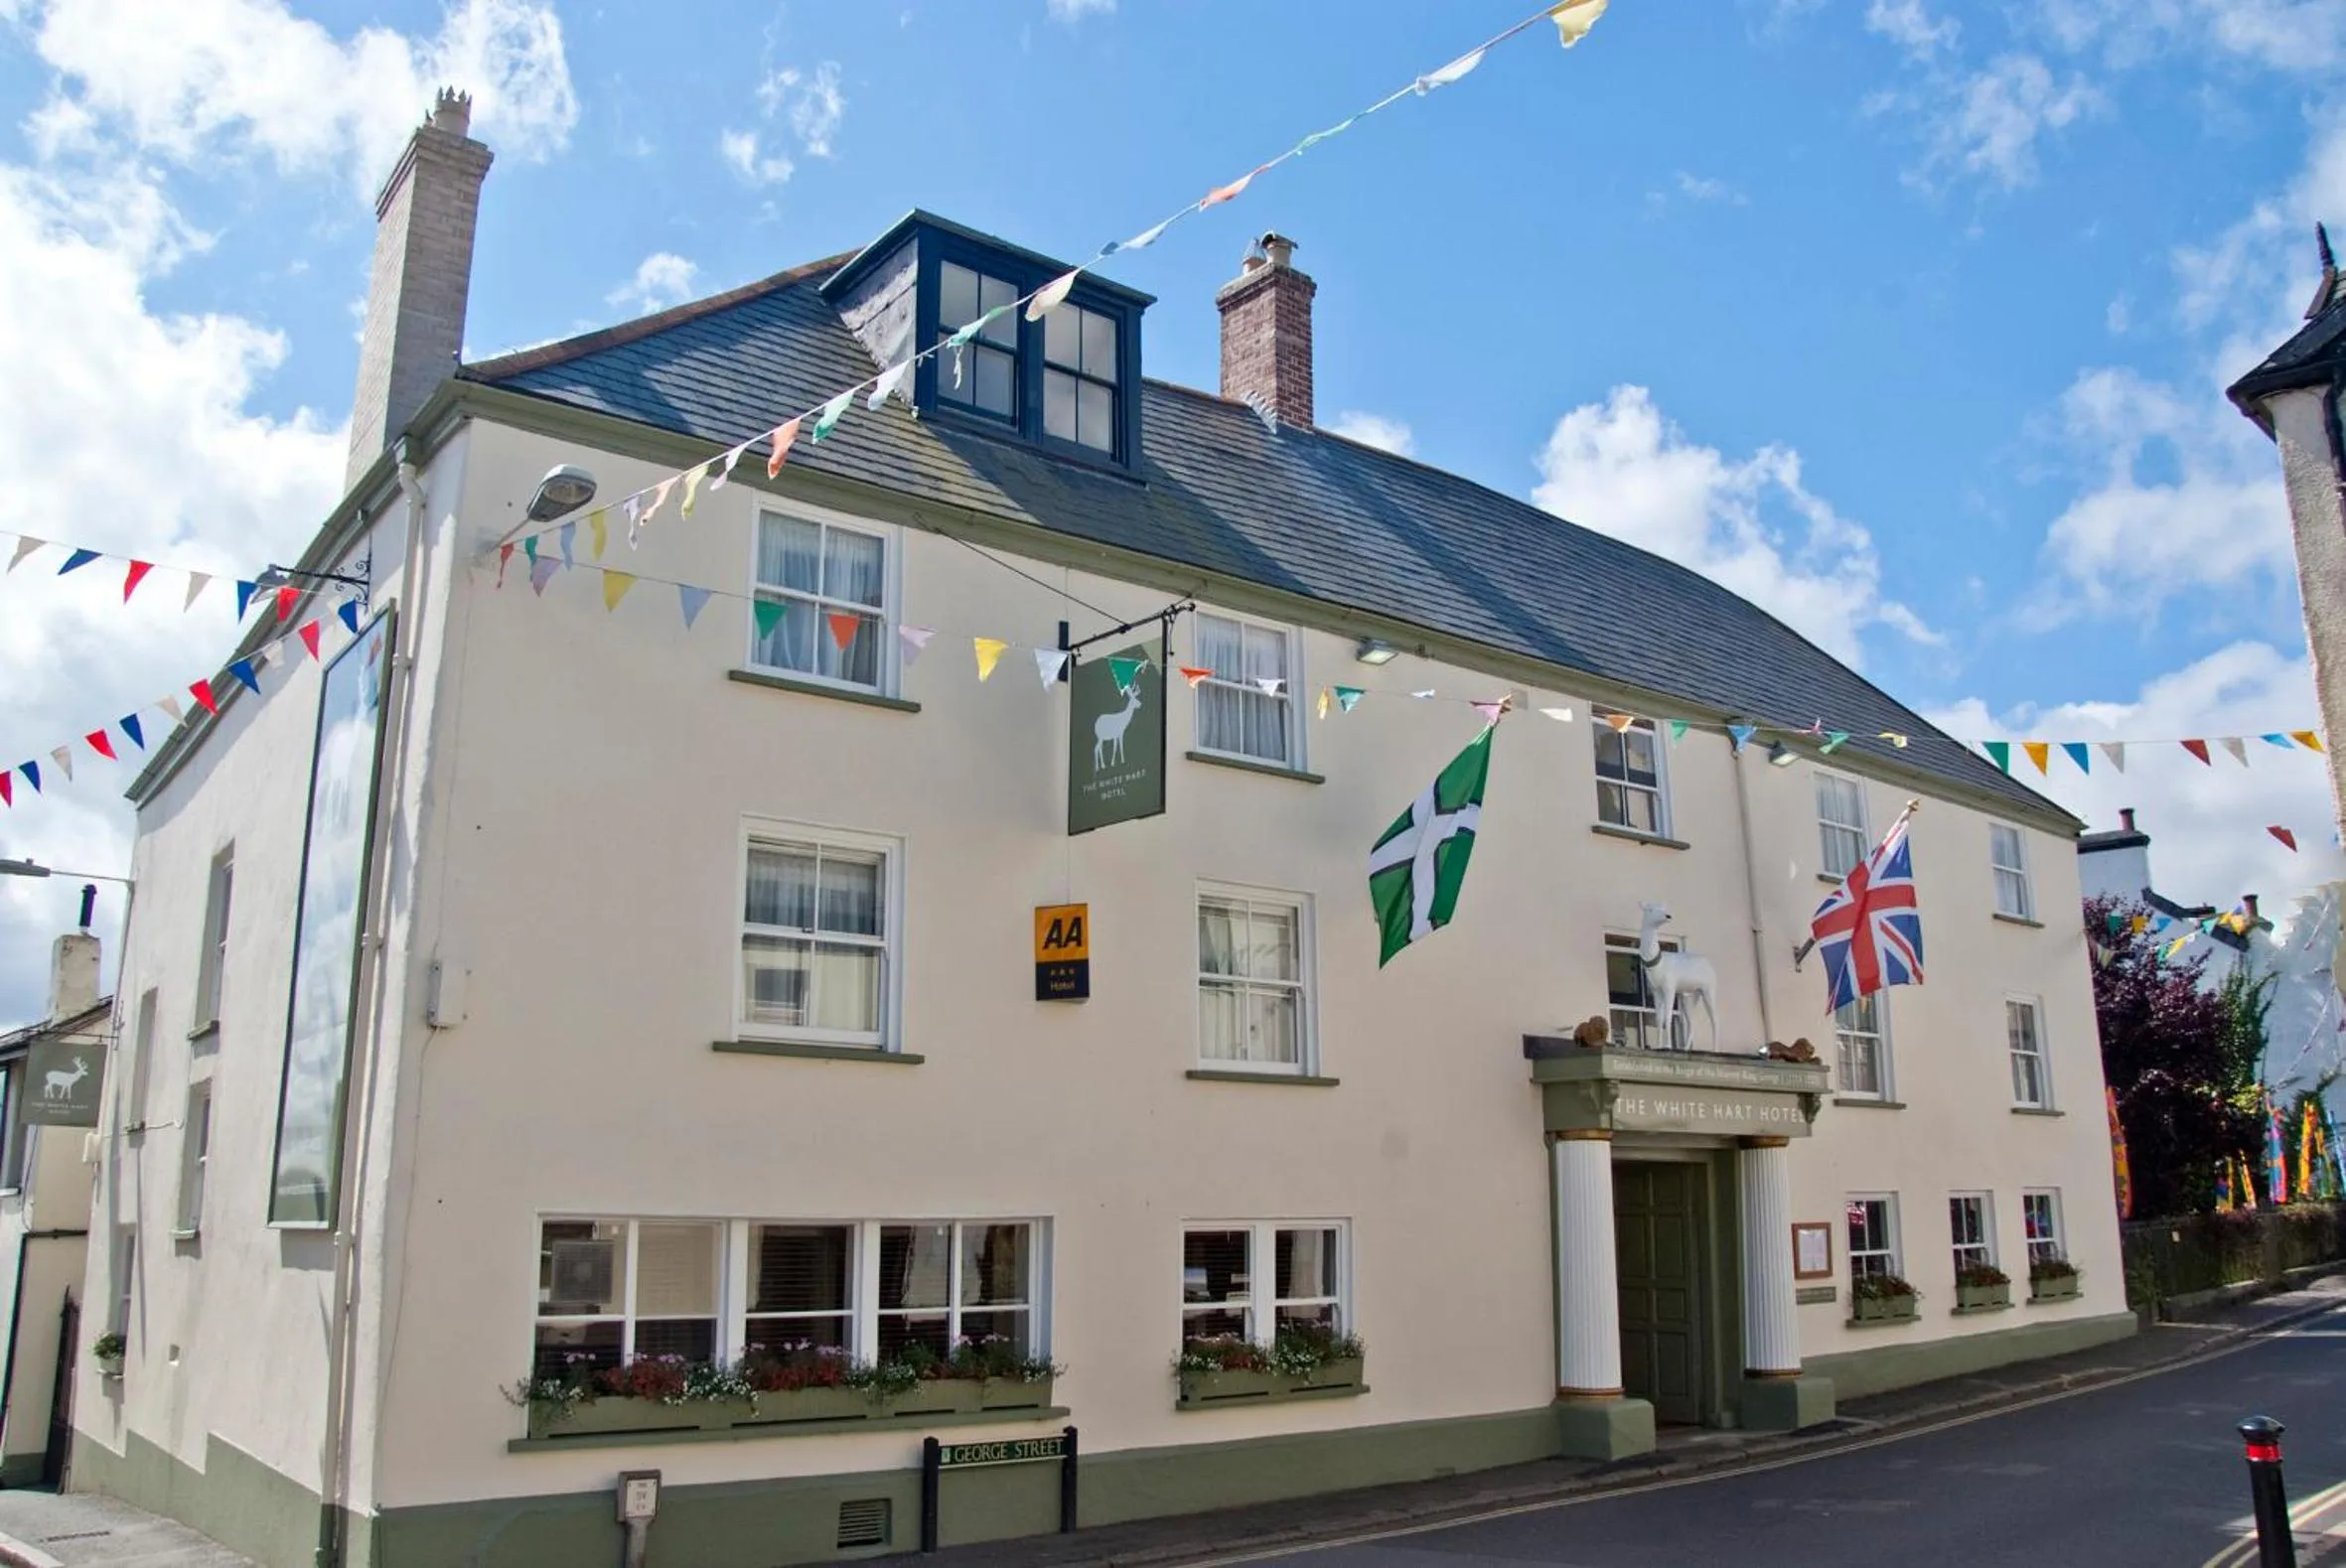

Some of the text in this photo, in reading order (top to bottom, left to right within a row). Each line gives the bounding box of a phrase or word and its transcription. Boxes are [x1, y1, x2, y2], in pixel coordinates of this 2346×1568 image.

[1042, 916, 1083, 950] AA
[1615, 1097, 1807, 1124] THE WHITE HART HOTEL
[954, 1438, 1065, 1463] GEORGE STREET
